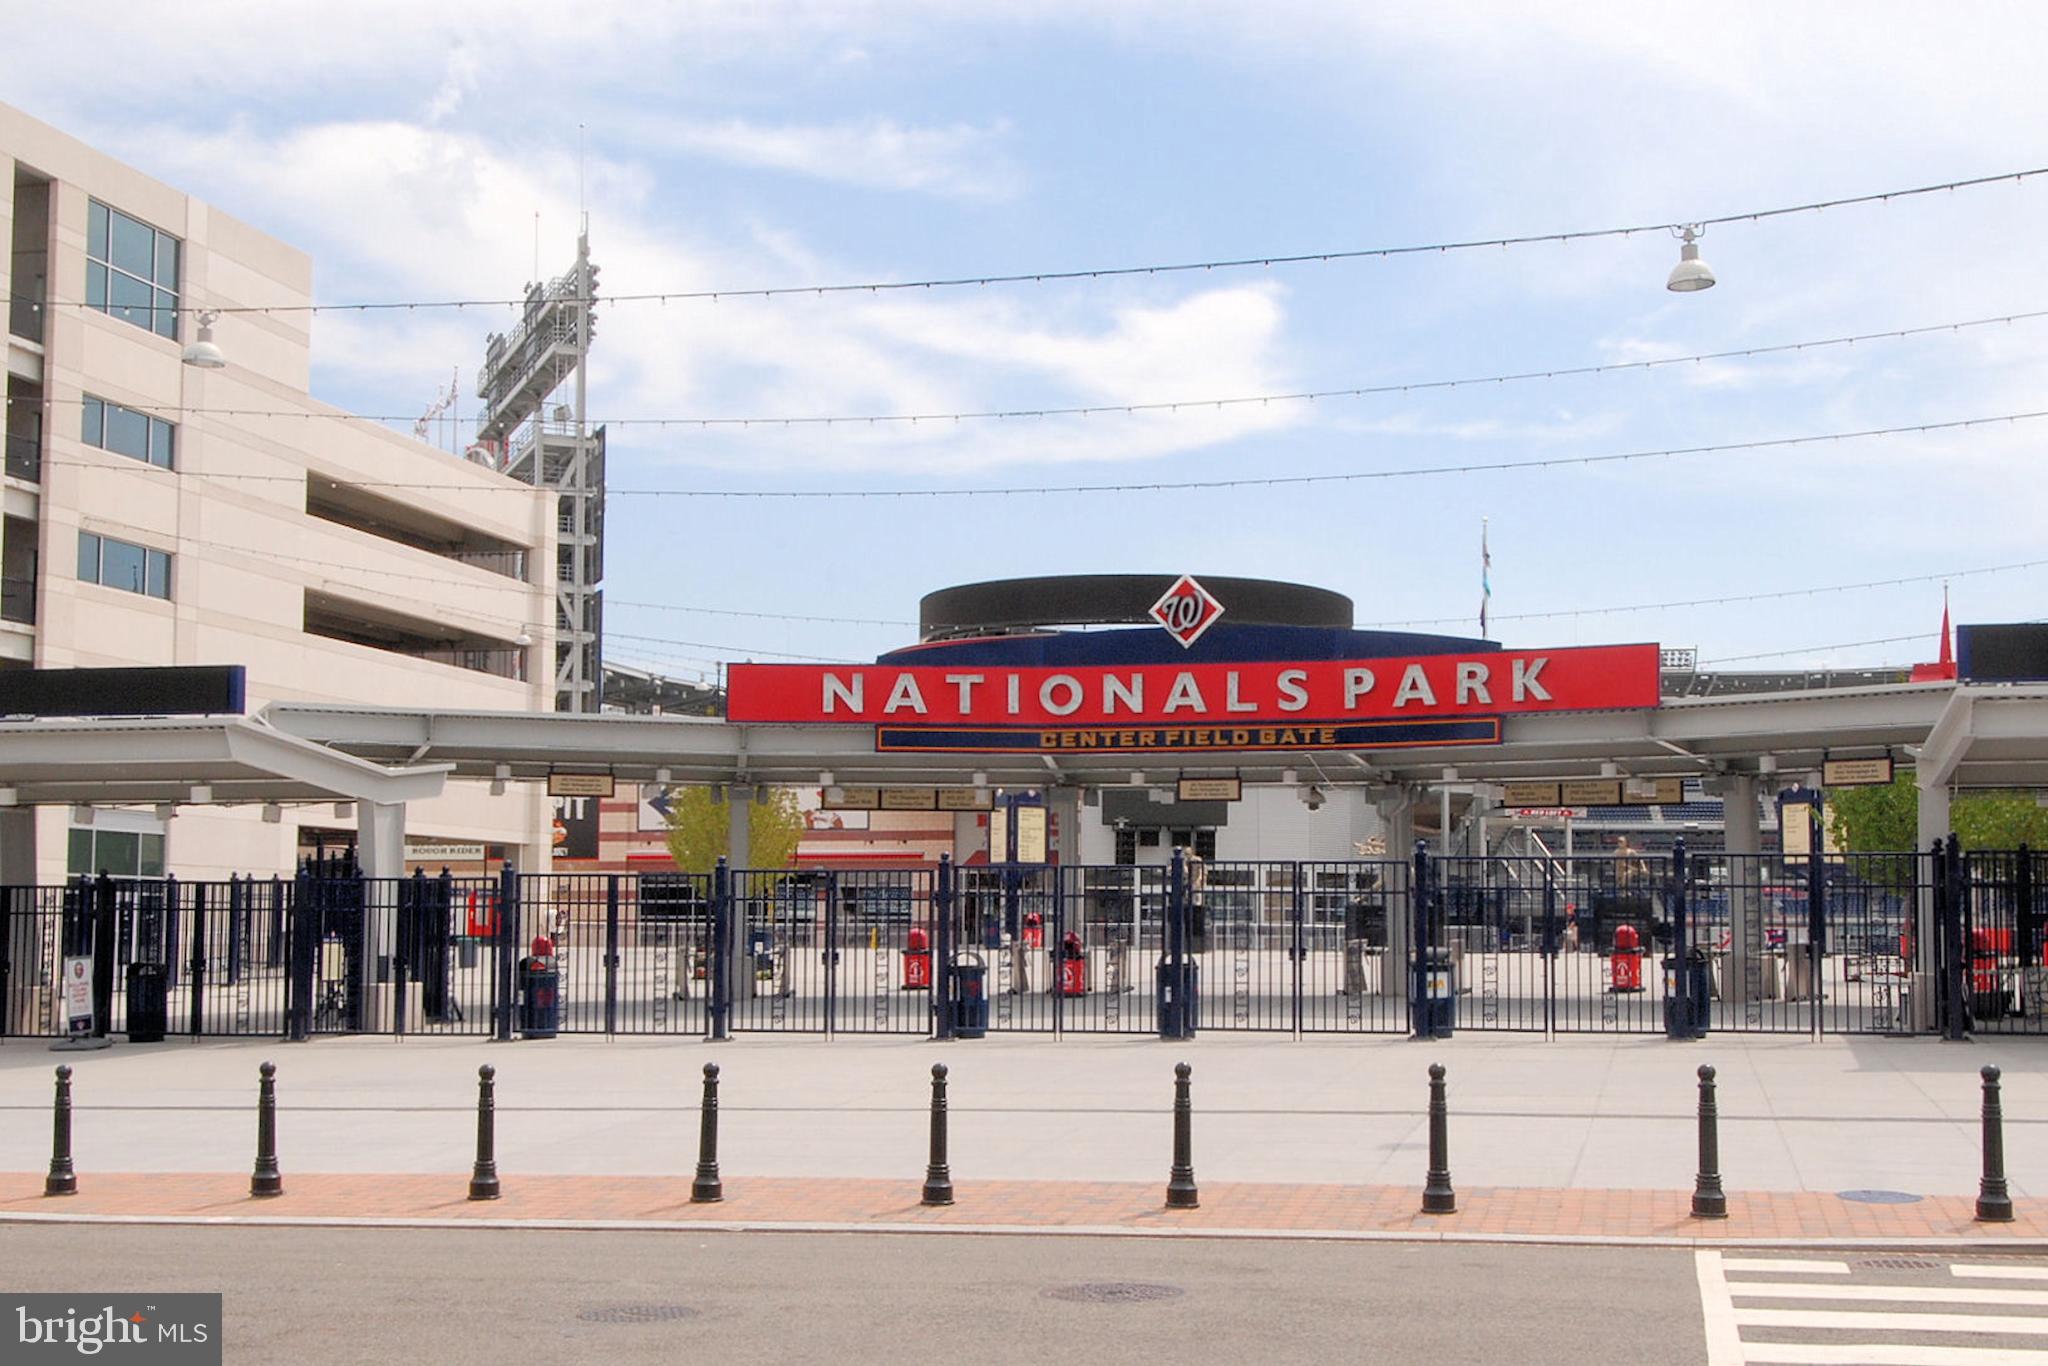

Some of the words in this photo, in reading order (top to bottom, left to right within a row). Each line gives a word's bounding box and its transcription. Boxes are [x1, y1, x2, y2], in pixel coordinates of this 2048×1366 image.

[821, 669, 1309, 716] NATIONALS
[1343, 657, 1553, 710] PARK
[1040, 731, 1158, 748] CENTER
[1165, 729, 1250, 747] FIELD
[1259, 728, 1337, 745] GATE
[412, 847, 447, 855] ROUGH
[449, 847, 482, 855] RIDER
